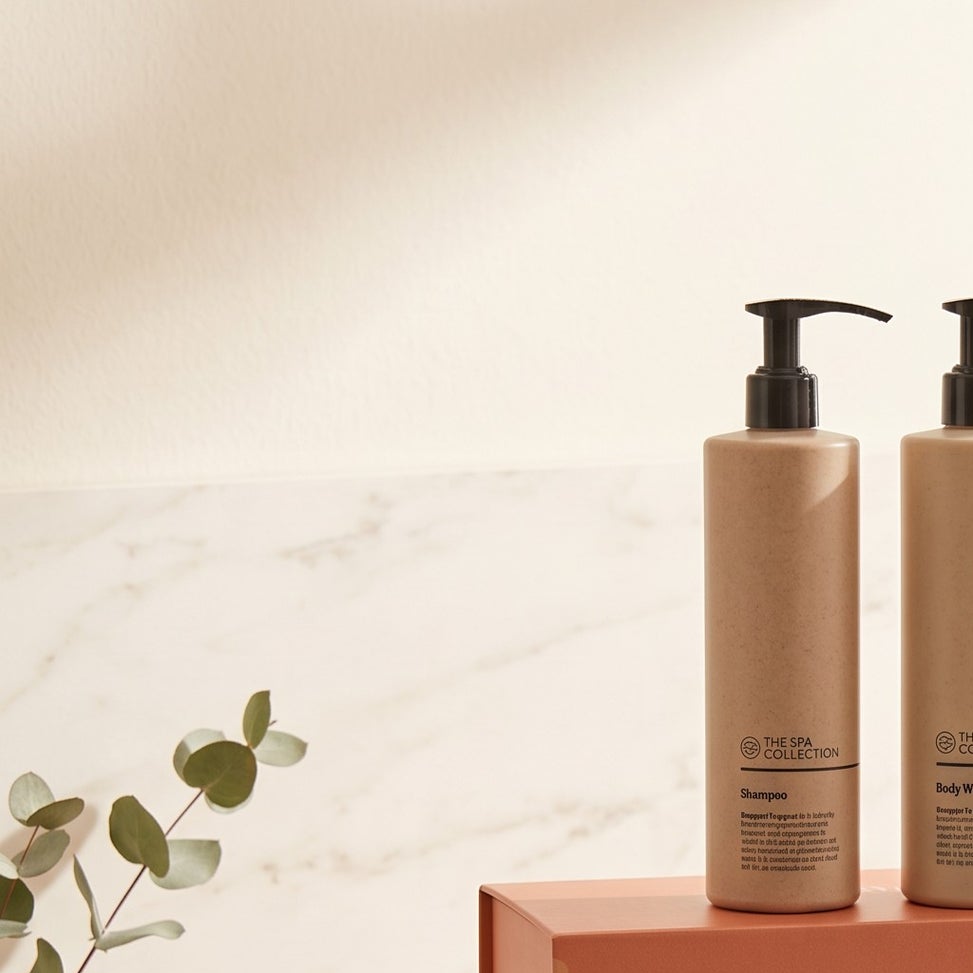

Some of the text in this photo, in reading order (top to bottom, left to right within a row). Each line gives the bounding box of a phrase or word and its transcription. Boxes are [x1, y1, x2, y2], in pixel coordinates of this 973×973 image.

[764, 736, 813, 748] THE SPA
[764, 747, 839, 760] COLLECTION
[741, 788, 788, 802] Shampoo
[936, 783, 961, 796] Body
